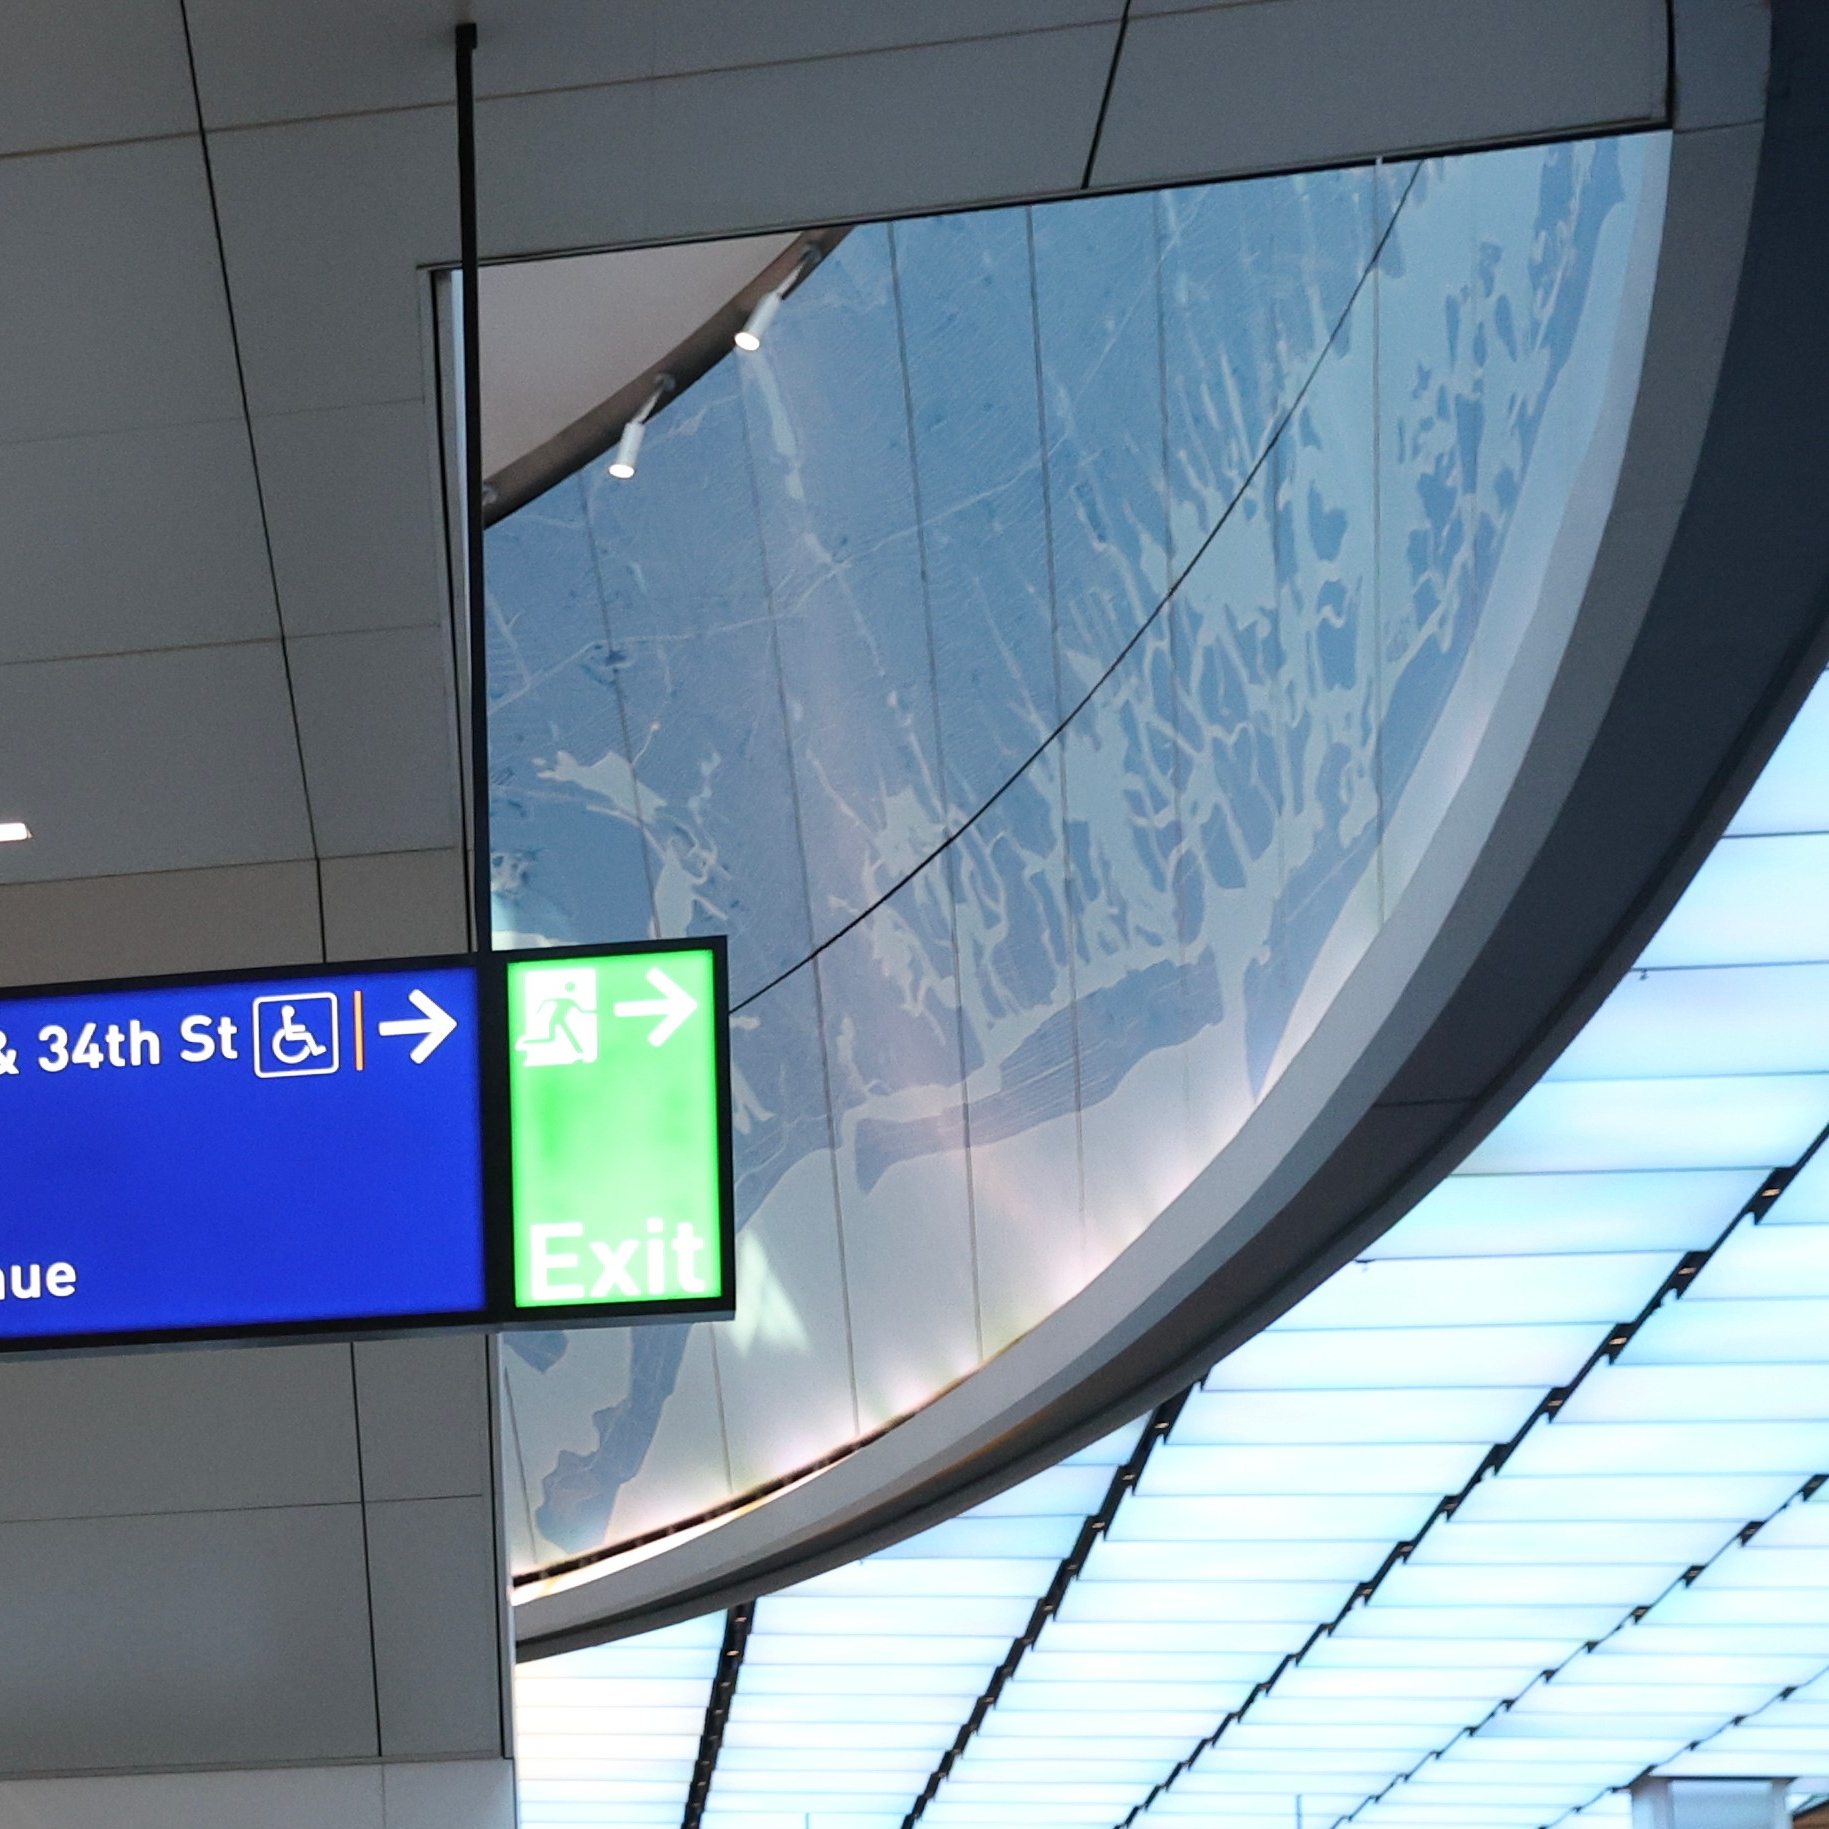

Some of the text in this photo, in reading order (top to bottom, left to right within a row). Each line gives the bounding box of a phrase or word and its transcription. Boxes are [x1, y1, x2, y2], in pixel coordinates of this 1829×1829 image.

[38, 1019, 160, 1072] 34th
[180, 1014, 238, 1062] St
[529, 1216, 709, 1301] Exit
